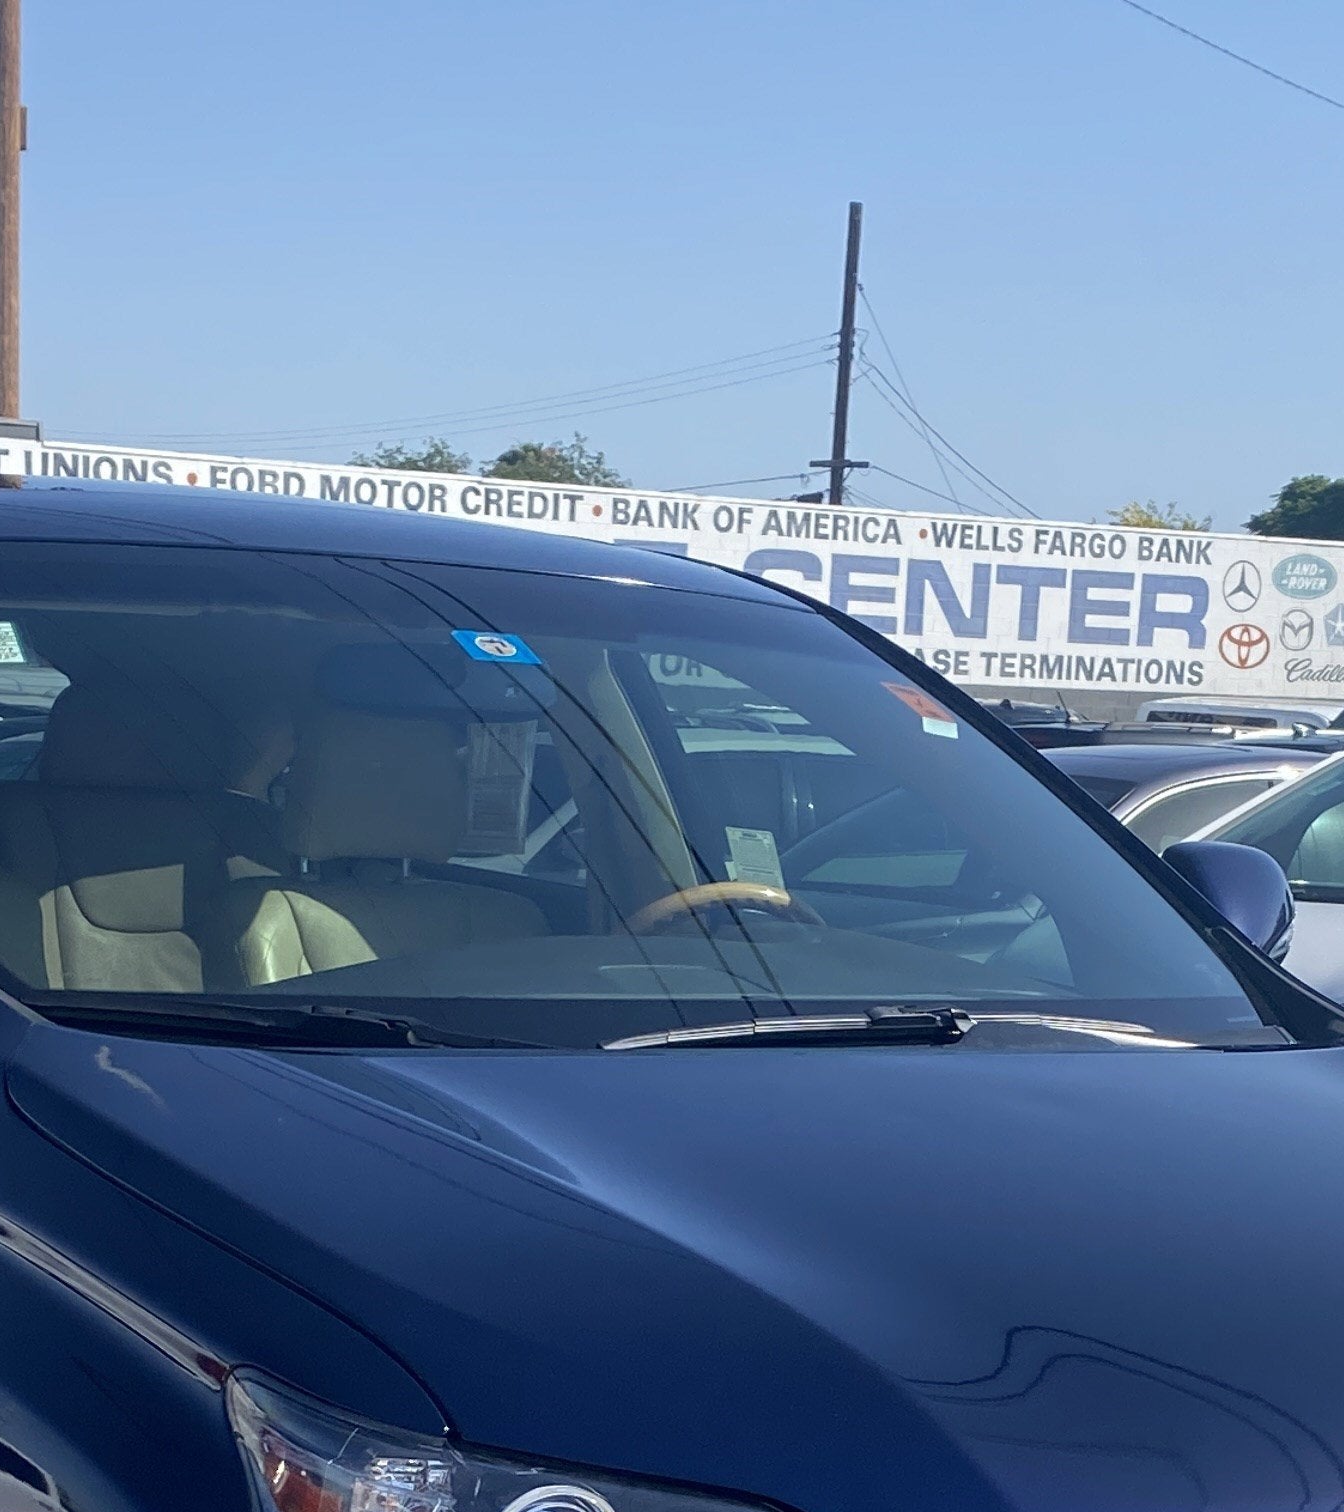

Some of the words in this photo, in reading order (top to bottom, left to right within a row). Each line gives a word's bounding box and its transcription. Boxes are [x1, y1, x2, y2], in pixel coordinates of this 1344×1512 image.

[24, 450, 173, 485] UNIONS
[209, 465, 305, 497] FORD
[319, 474, 448, 512] MOTOR
[460, 486, 584, 522] CREDIT
[611, 497, 701, 531] BANK
[713, 505, 754, 535] OF
[761, 509, 903, 545] AMERICA
[931, 522, 1023, 553] WELLS
[1033, 529, 1127, 560] FARGO
[1137, 535, 1213, 565] BANK
[981, 651, 1204, 687] TERMINATIONS
